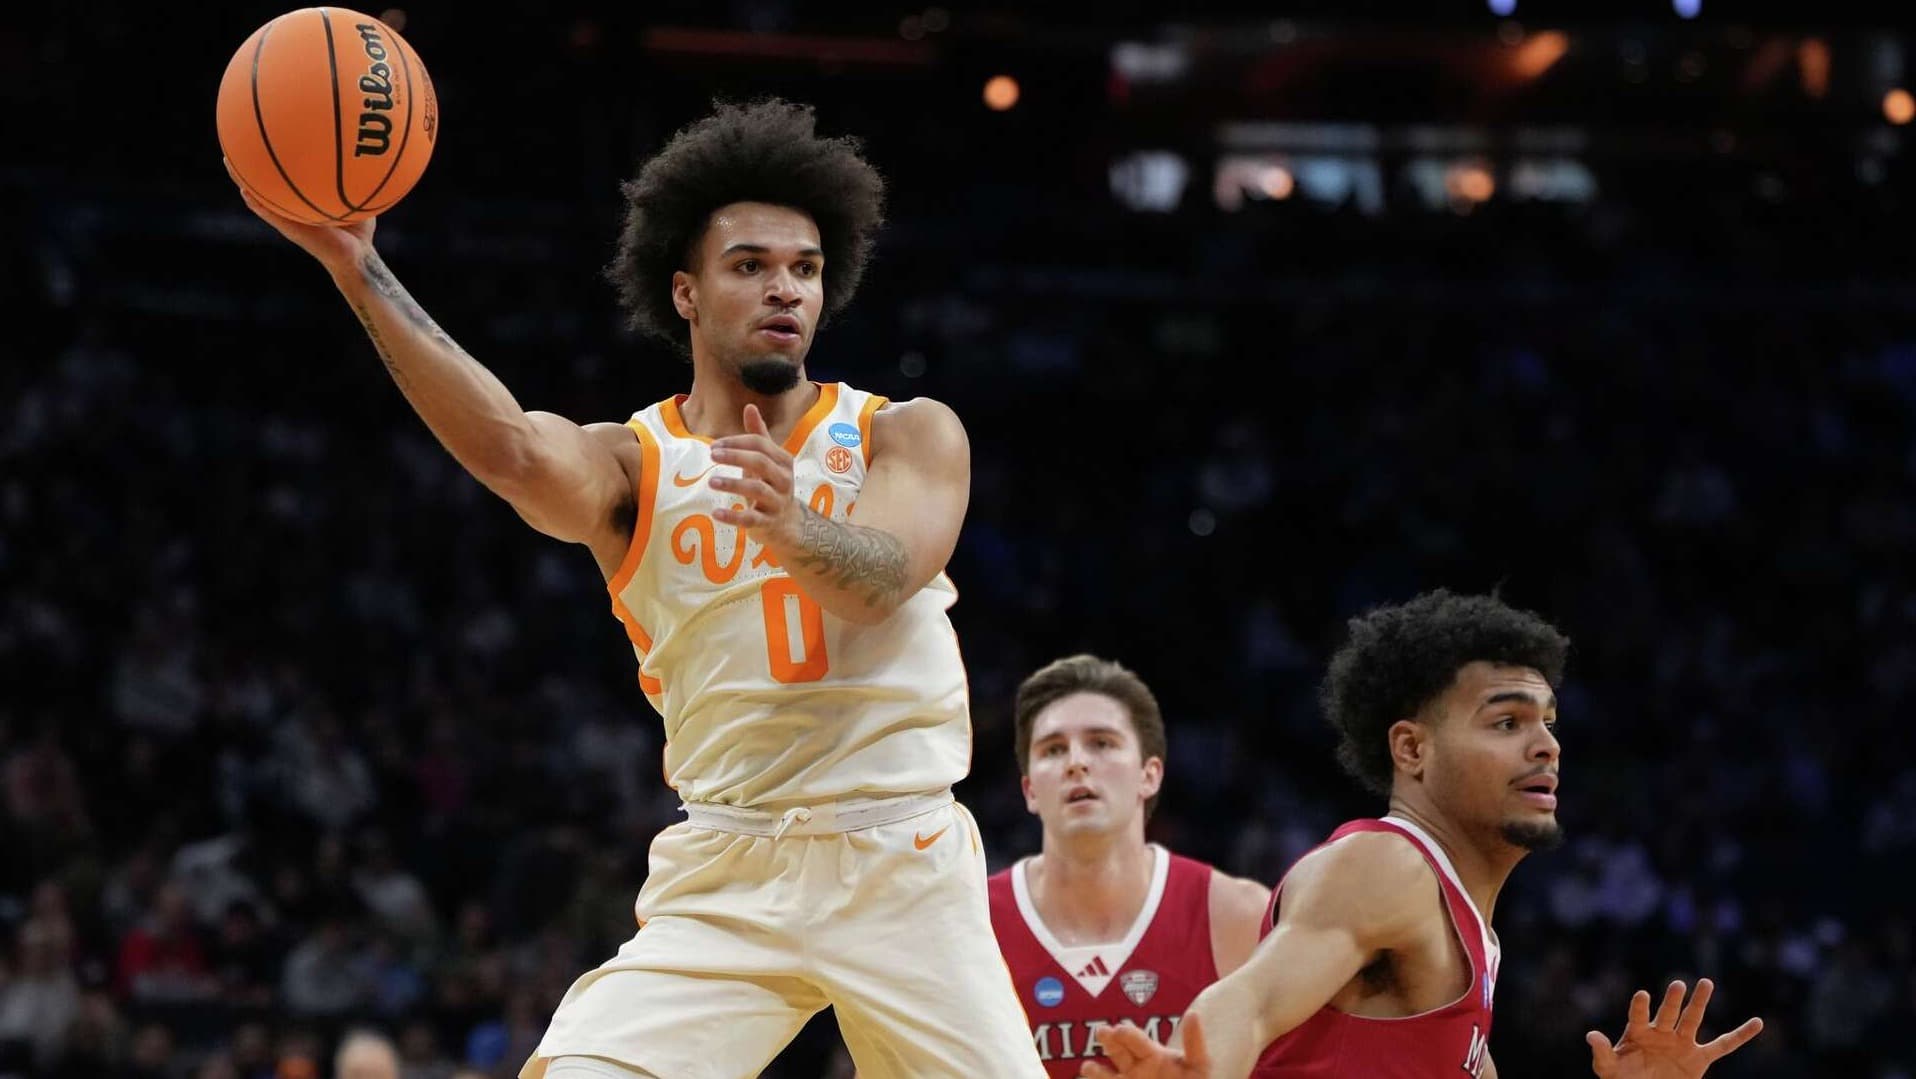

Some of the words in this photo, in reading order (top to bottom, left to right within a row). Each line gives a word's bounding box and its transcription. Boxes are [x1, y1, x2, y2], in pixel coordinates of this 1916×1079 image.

[354, 23, 394, 158] Wilson
[828, 449, 850, 470] SEC
[760, 576, 829, 684] 0
